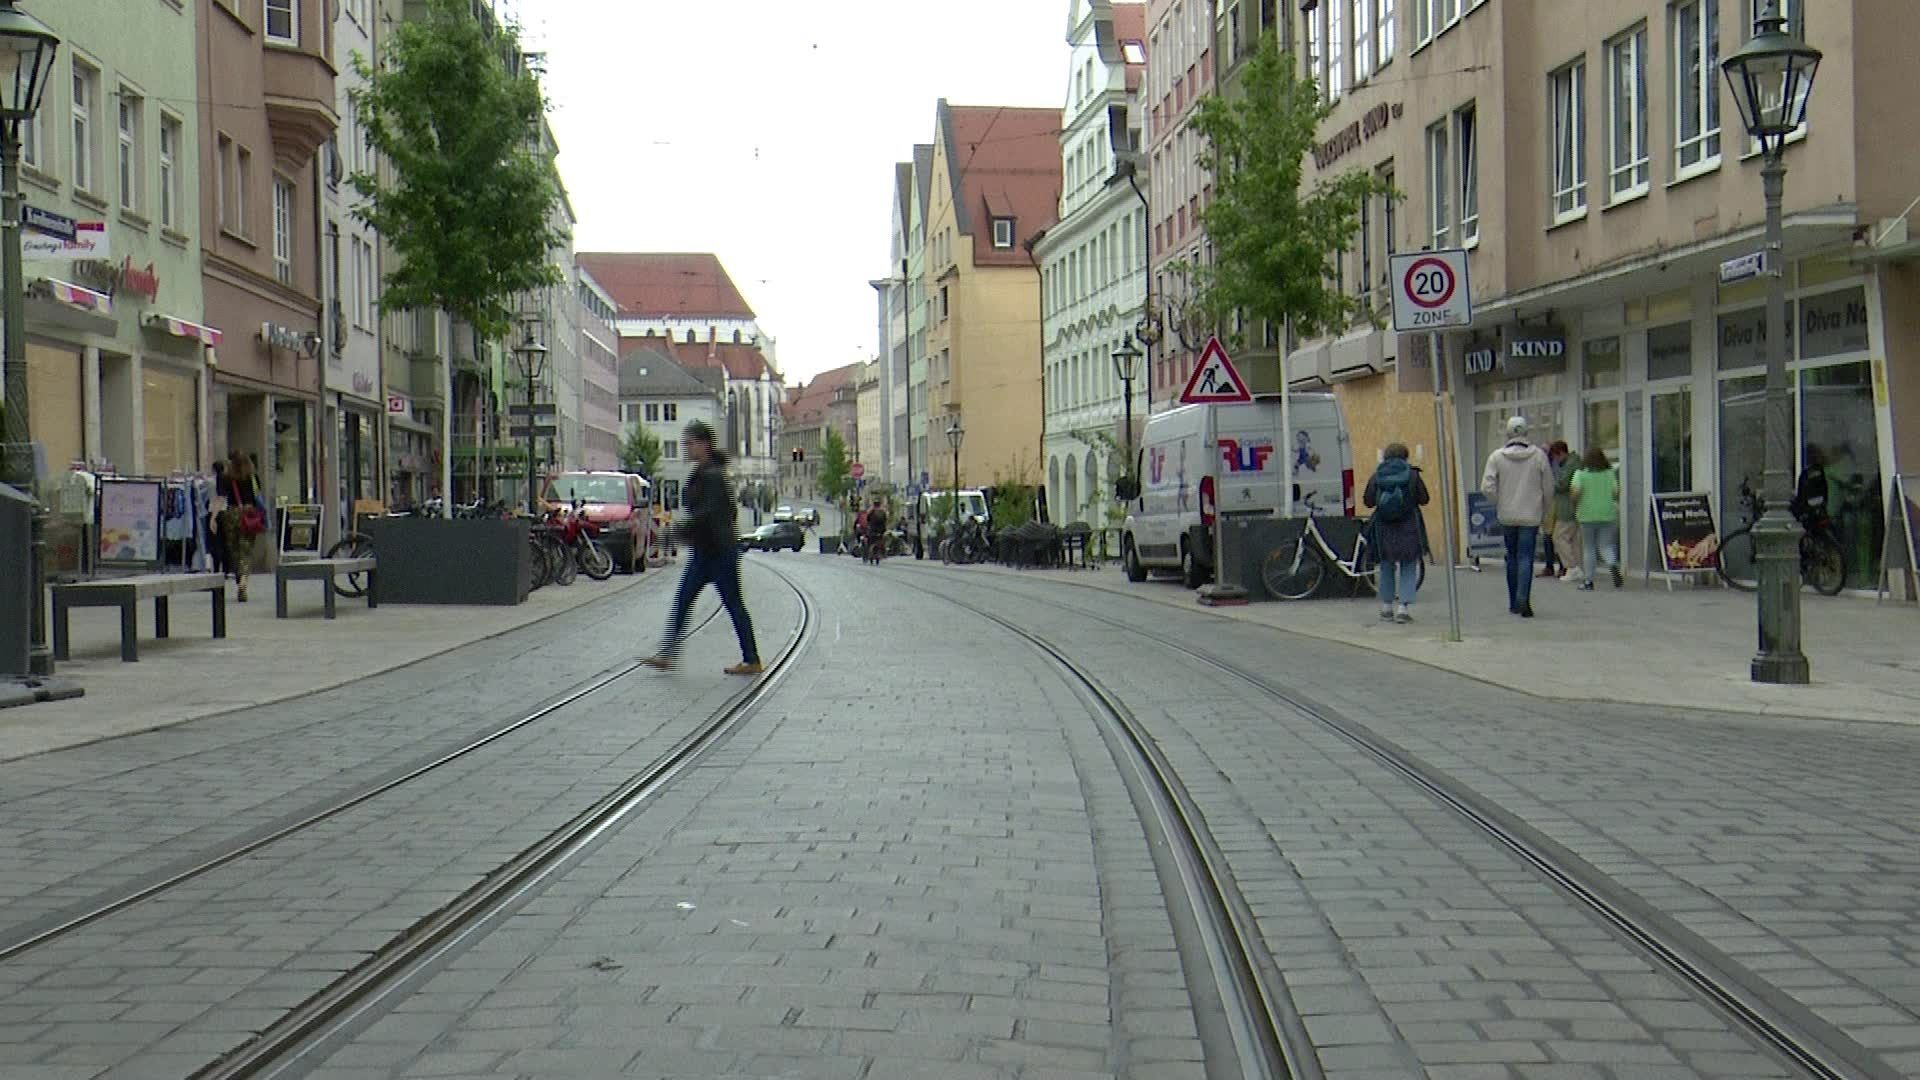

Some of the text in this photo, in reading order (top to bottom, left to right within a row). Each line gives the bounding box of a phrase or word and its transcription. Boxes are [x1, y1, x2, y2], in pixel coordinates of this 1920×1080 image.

[1415, 271, 1444, 295] 20
[1413, 310, 1451, 324] ZONE
[1806, 308, 1841, 334] Diva
[1723, 322, 1752, 347] Diva
[1511, 340, 1563, 357] KIND
[1465, 350, 1493, 375] KIND
[1217, 439, 1273, 472] RUF
